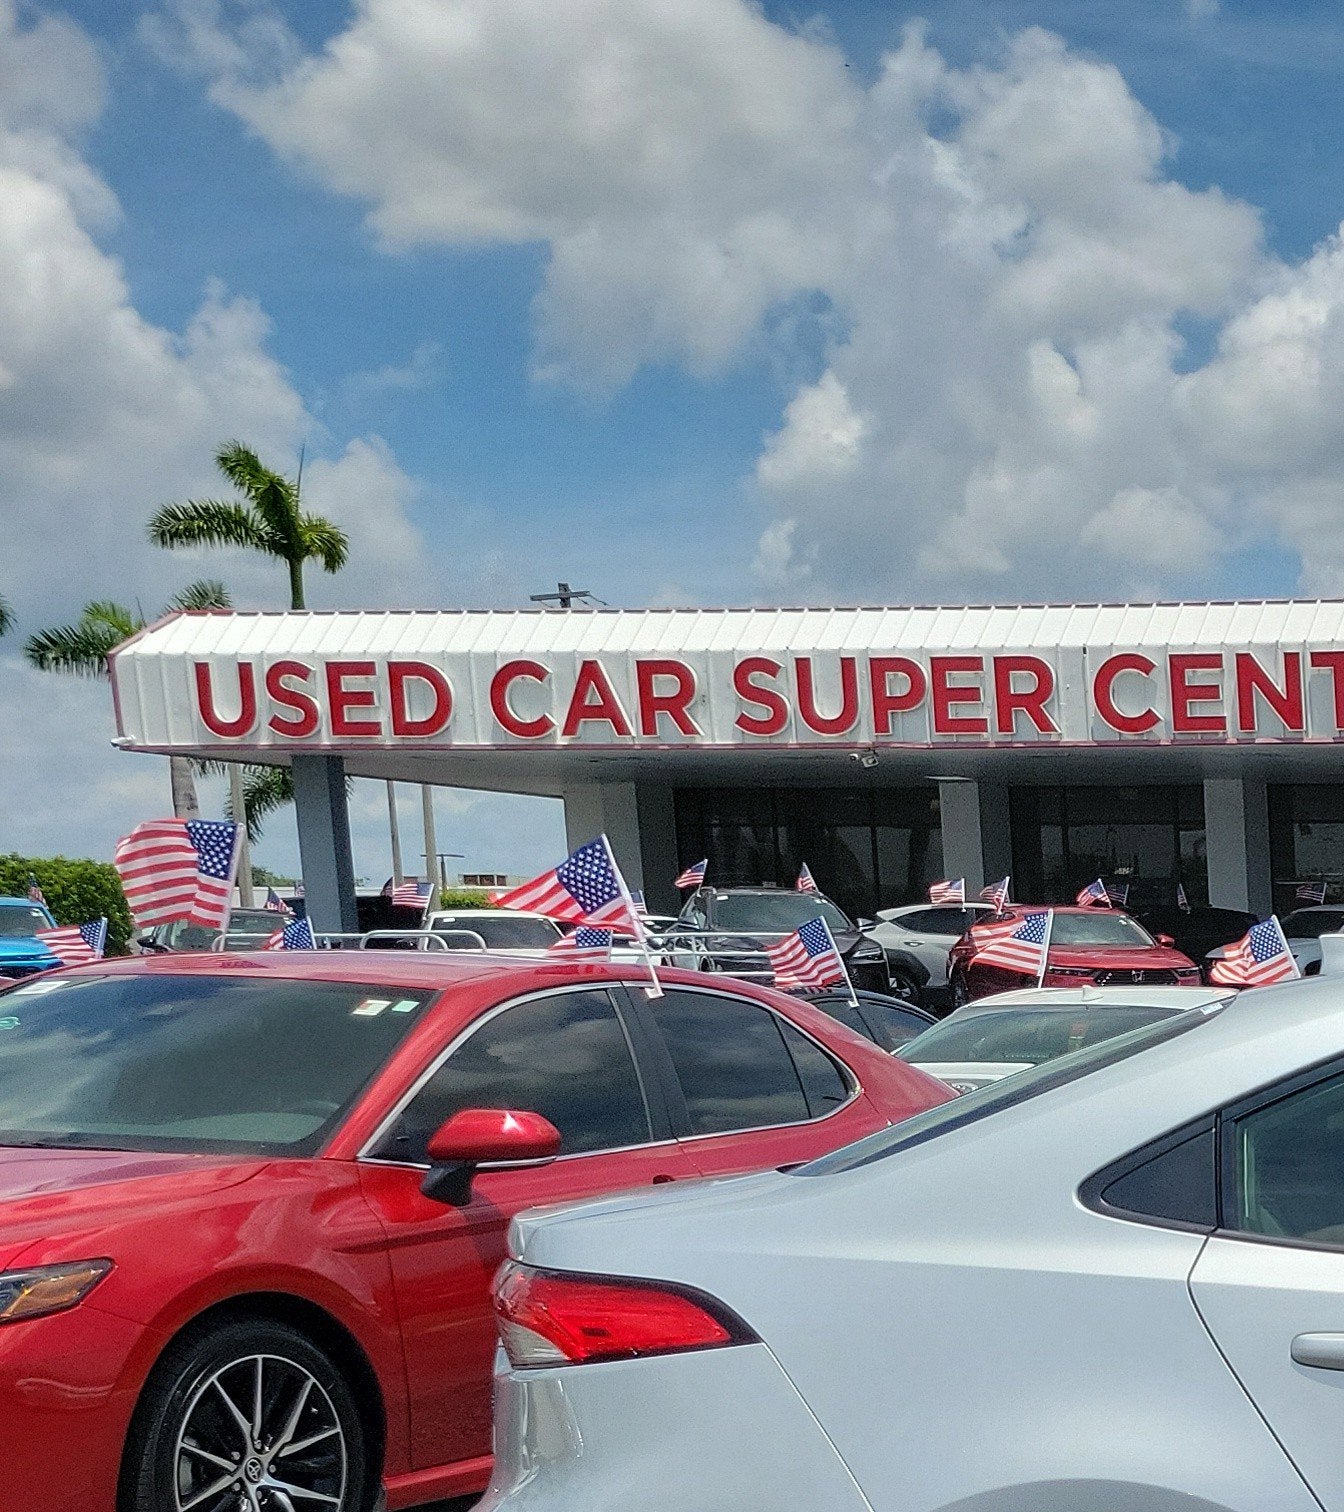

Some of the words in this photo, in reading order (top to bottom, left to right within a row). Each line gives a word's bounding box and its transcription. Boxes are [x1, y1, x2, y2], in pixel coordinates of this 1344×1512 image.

[194, 660, 455, 738] USED
[489, 658, 705, 738] CAR
[732, 655, 1063, 737] SUPER
